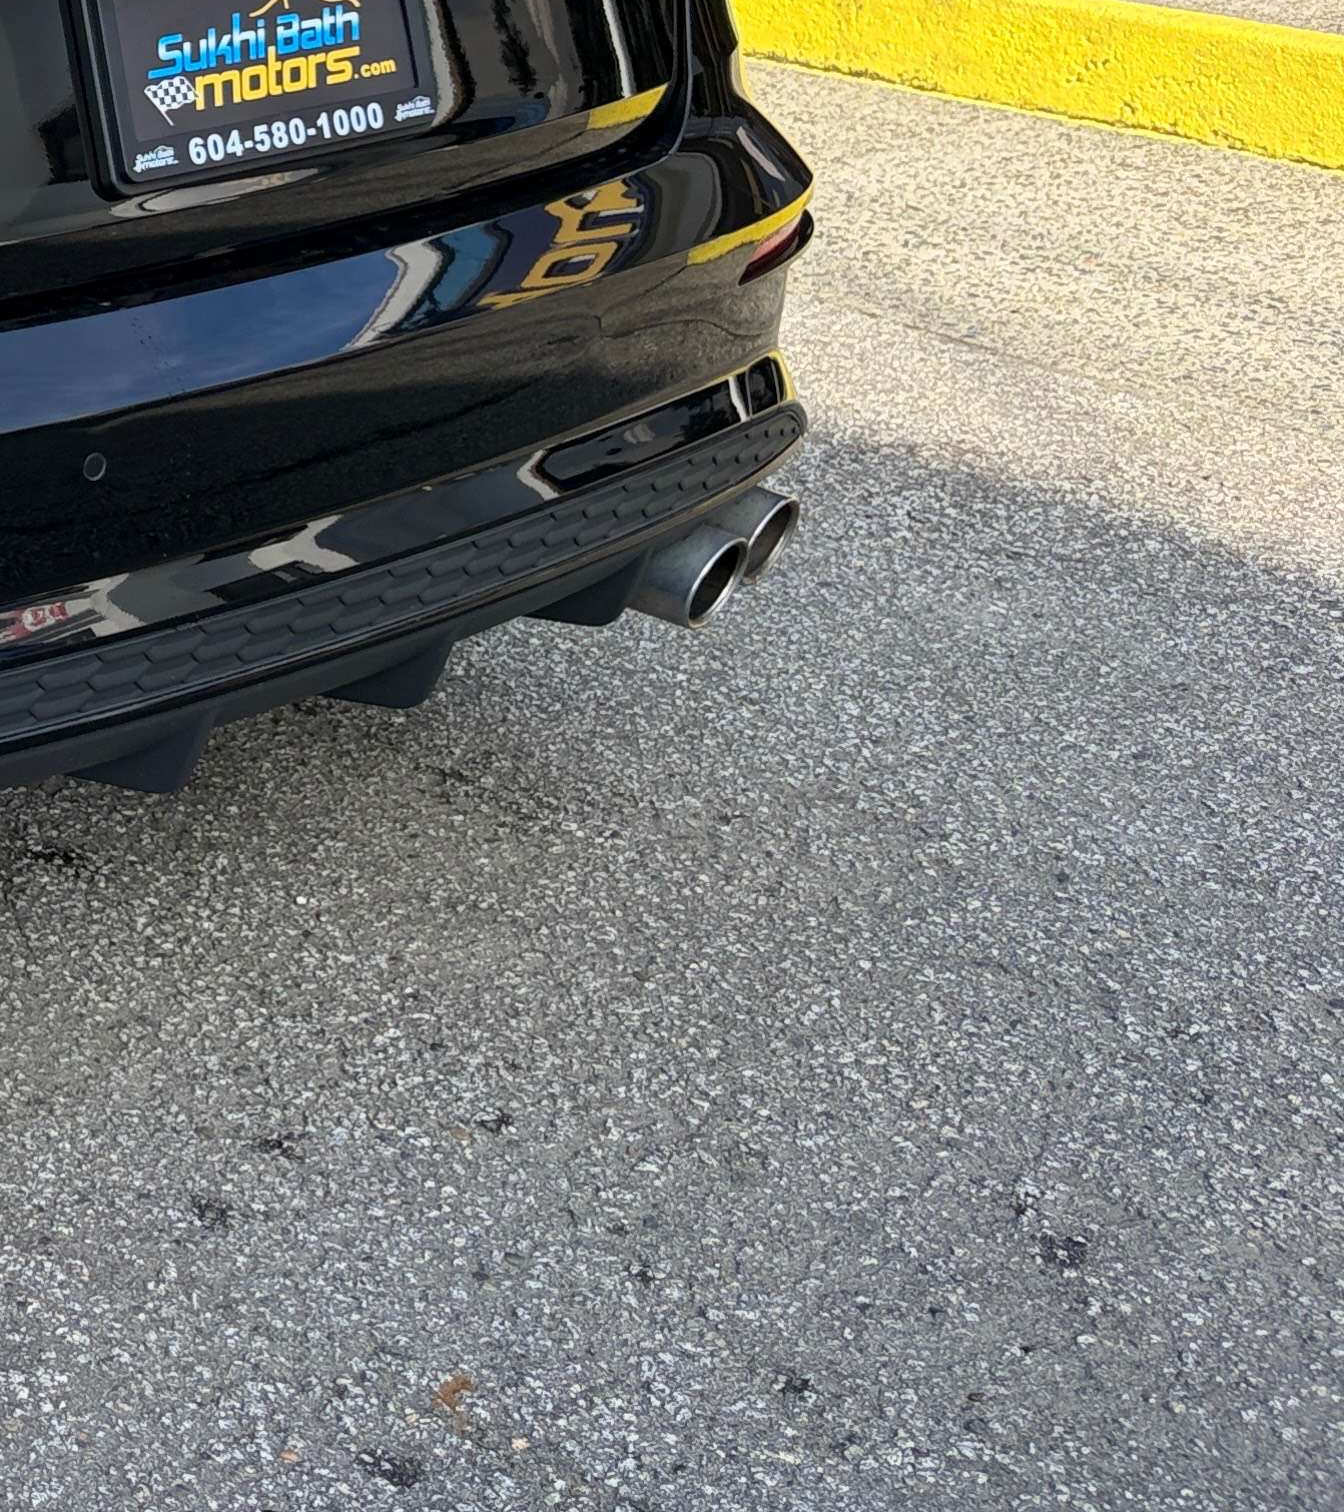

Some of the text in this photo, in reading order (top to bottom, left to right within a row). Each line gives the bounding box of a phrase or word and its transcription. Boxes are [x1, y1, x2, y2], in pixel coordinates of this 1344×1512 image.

[148, 4, 361, 80] Sukhi Bath
[188, 102, 385, 166] 604-580-1000
